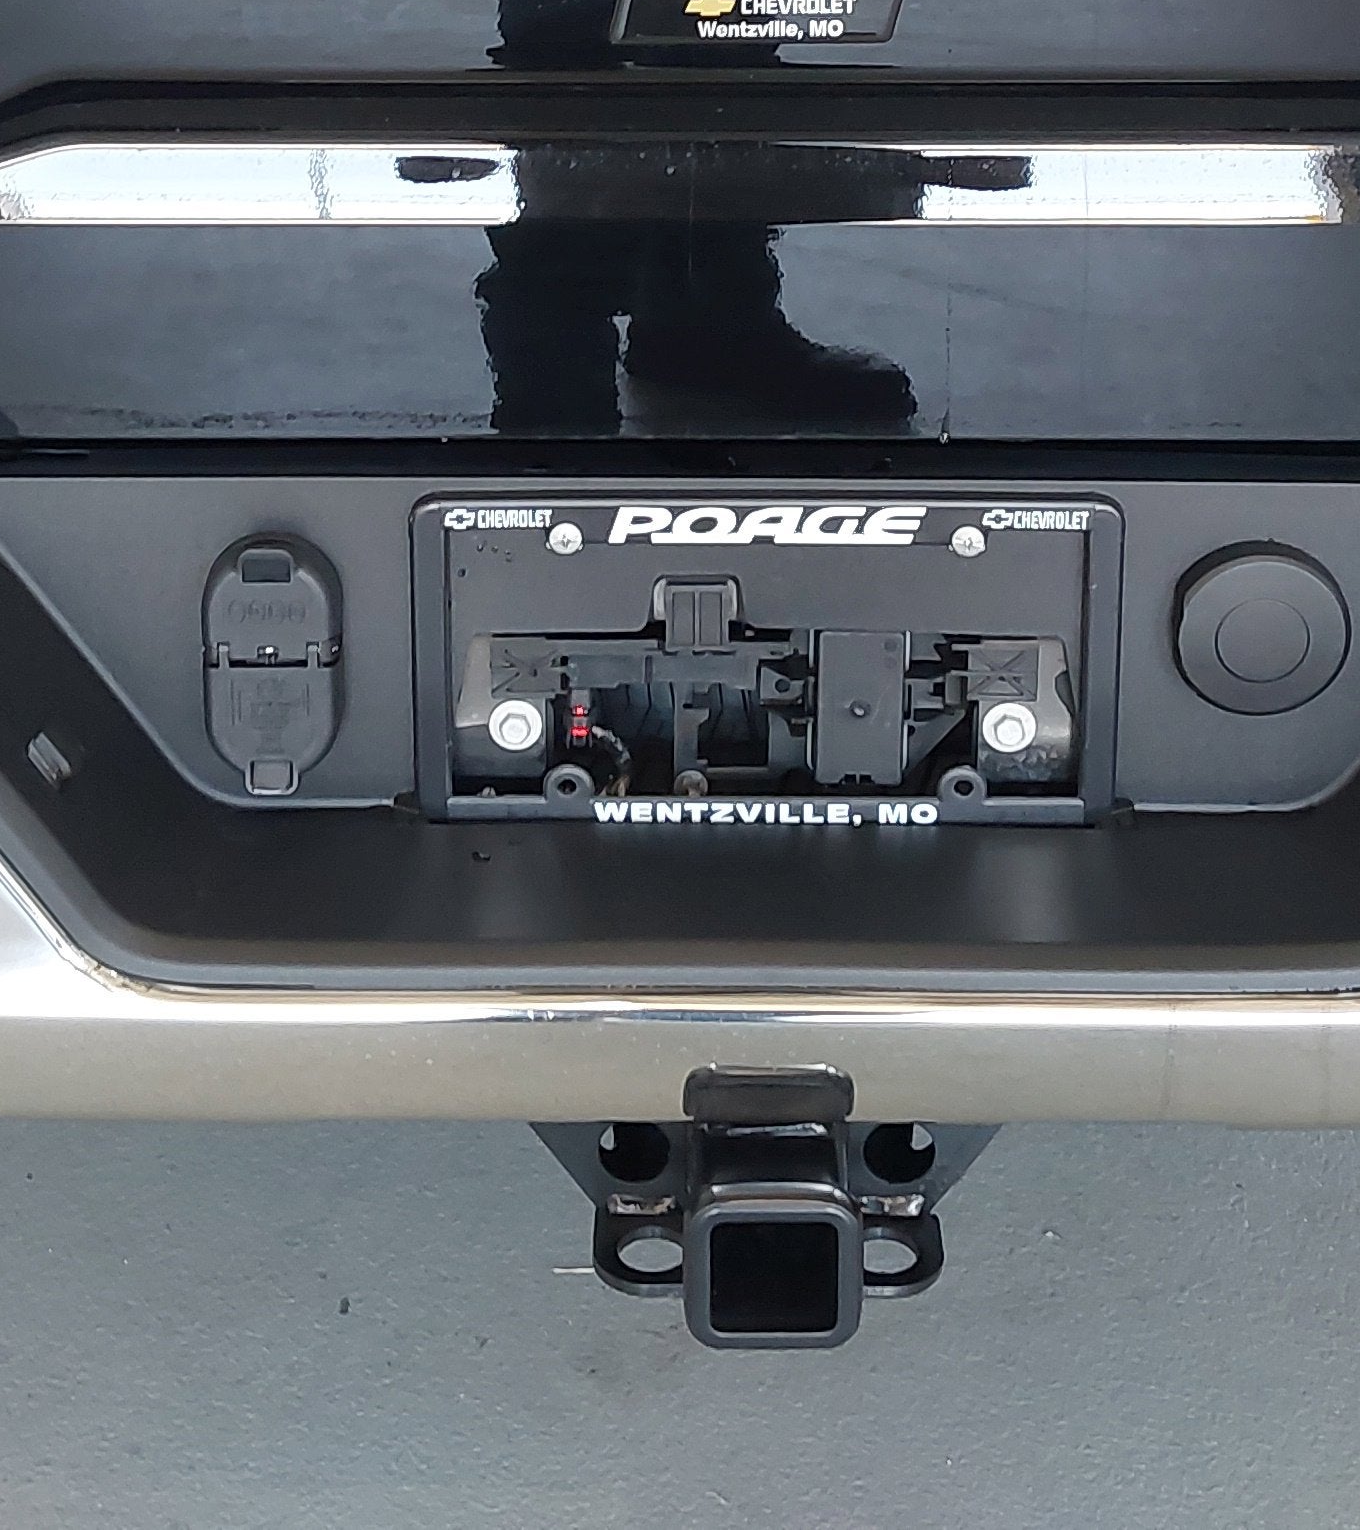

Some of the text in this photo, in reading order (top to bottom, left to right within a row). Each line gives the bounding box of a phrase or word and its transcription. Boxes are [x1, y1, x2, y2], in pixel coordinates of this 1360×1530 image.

[697, 19, 844, 40] Wentzville, MO
[477, 509, 552, 529] CHEVROLET
[607, 505, 928, 545] POAGE
[1013, 510, 1090, 530] CHEVROLET
[593, 801, 939, 826] WENTZVILLE, MO
